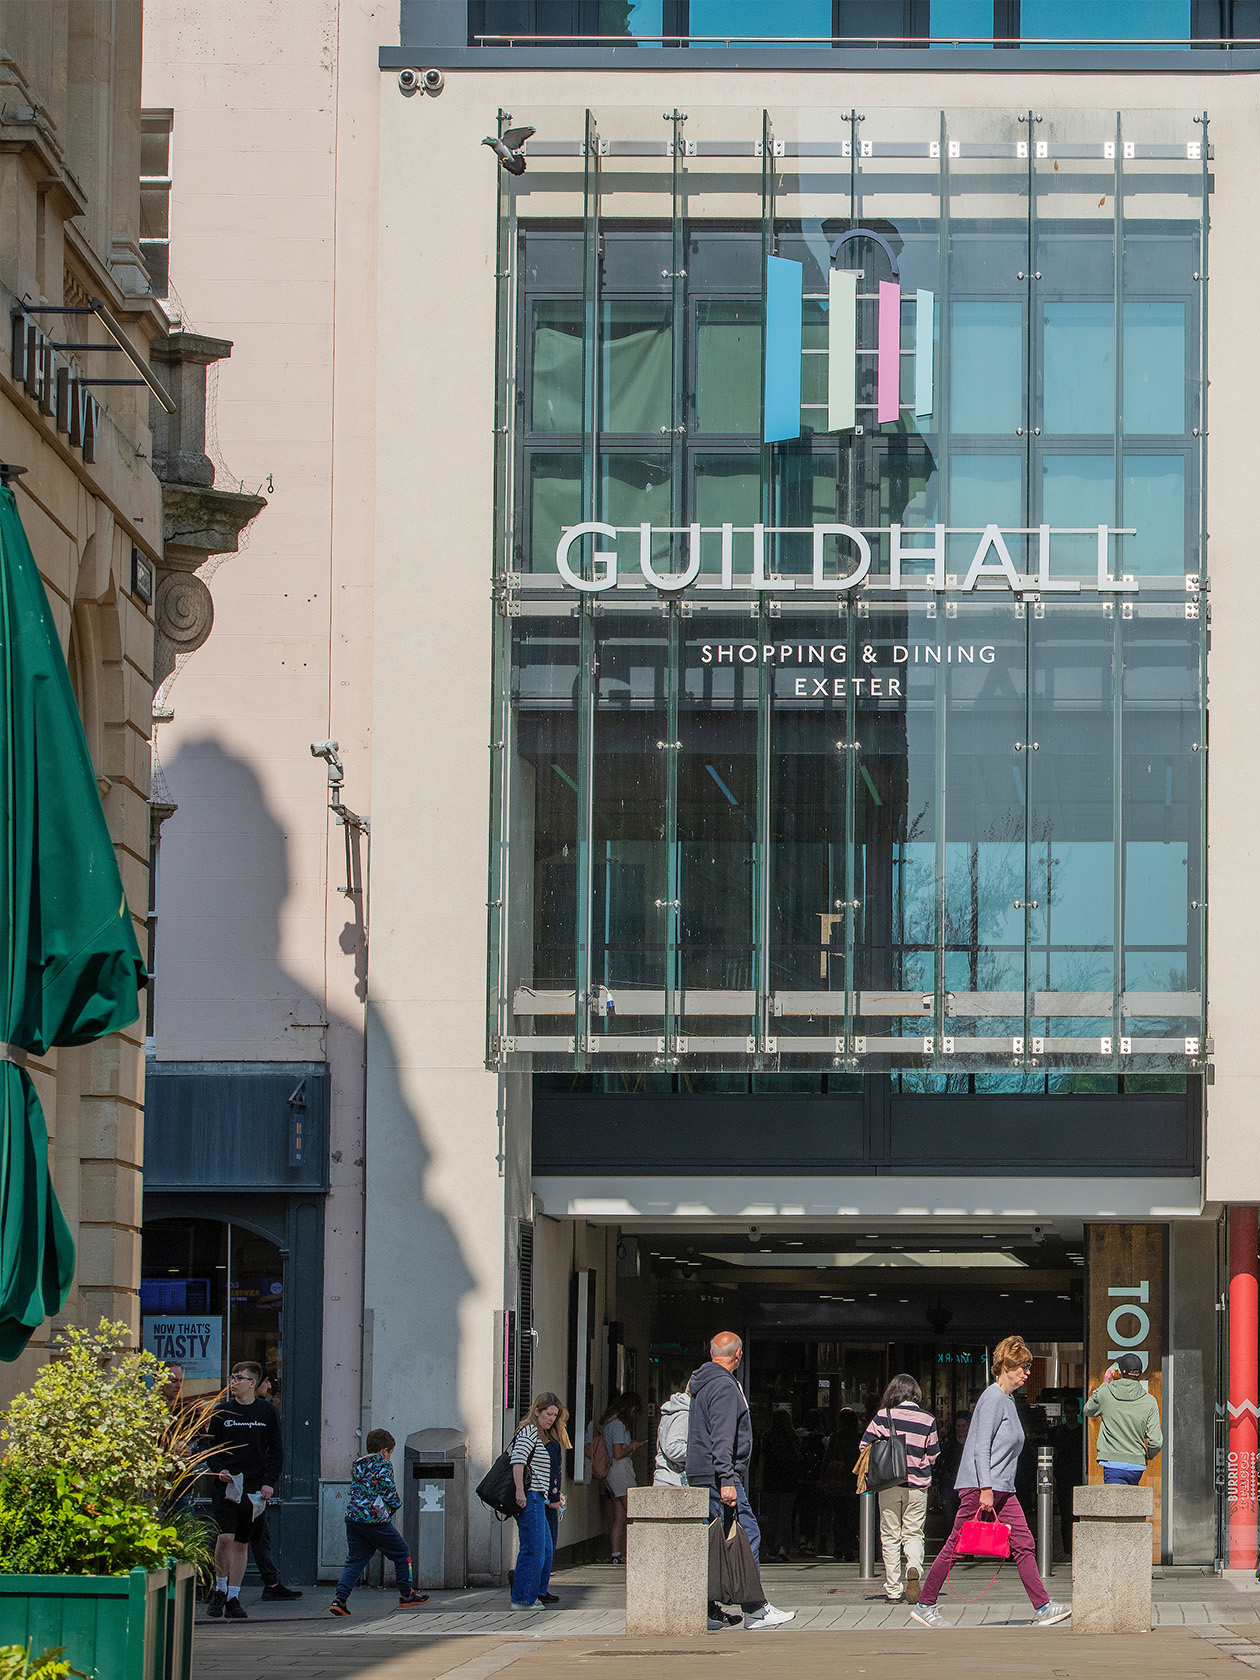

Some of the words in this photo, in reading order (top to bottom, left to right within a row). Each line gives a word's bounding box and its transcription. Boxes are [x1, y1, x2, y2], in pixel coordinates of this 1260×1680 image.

[555, 522, 1141, 592] GUILDHALL
[701, 644, 848, 664] SHOPPING
[861, 644, 877, 664] &
[892, 644, 997, 664] DINING
[794, 678, 904, 697] EXETER
[153, 1323, 176, 1334] NOW
[178, 1323, 211, 1334] THAT'S
[153, 1334, 211, 1358] TASTY
[223, 1419, 267, 1429] Champion
[1227, 1451, 1239, 1502] BURRITO
